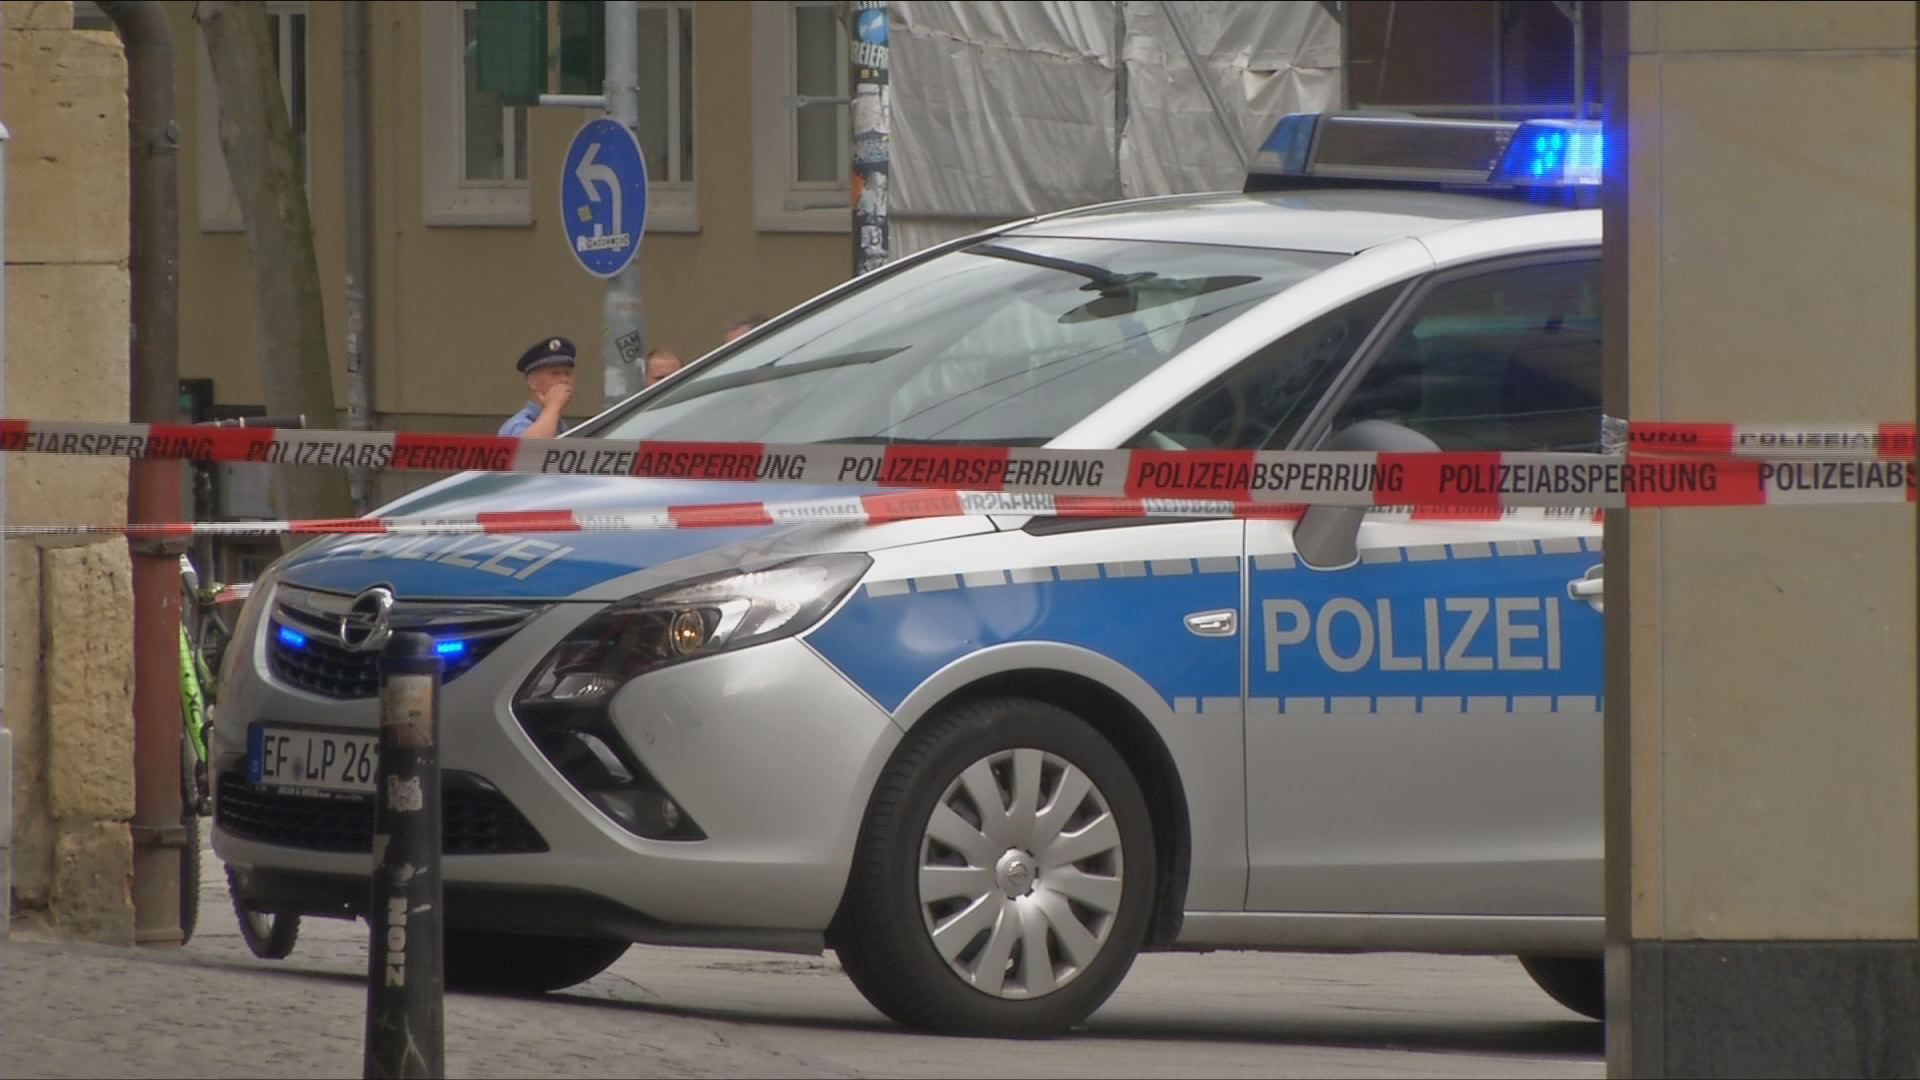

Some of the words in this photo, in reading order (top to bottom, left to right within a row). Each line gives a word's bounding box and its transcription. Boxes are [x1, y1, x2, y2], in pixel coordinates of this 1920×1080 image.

[247, 439, 511, 472] POLIZEIABSPERRUNG
[541, 449, 806, 481] POLIZEIABSPERRUNG
[838, 456, 1103, 487] POLIZEIABSPERRUNG
[1137, 461, 1404, 492] POLIZEIABSPERRUNG
[1439, 464, 1717, 494] POLIZEIABSPERRUNG
[1262, 597, 1561, 673] POLIZEI
[263, 735, 290, 777] EF
[305, 739, 336, 780] LP
